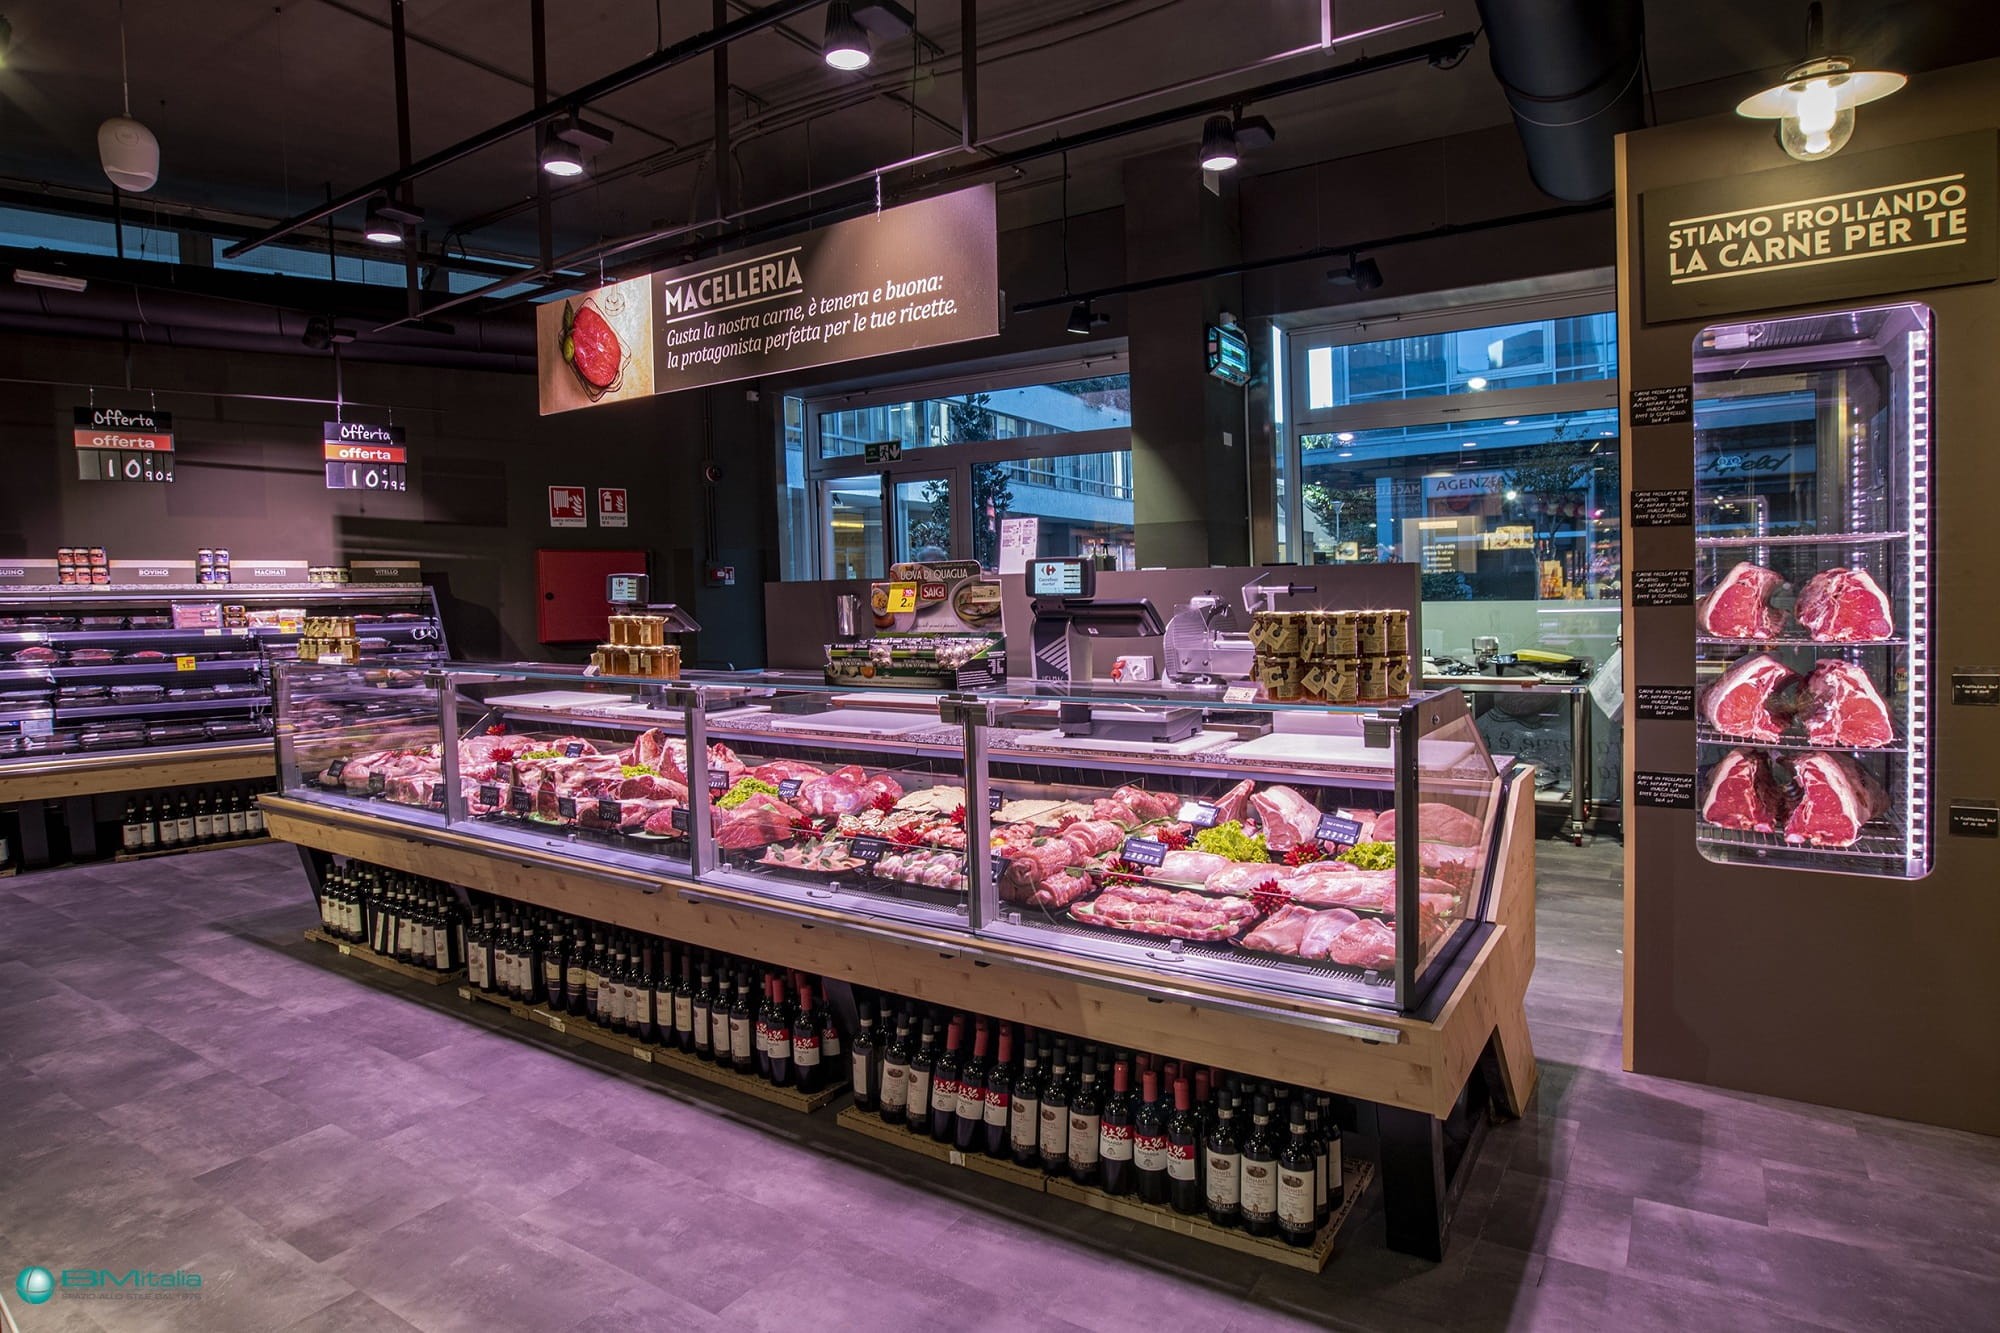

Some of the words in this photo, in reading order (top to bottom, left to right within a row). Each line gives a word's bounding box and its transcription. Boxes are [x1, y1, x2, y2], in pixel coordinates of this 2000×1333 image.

[1669, 215, 1772, 250] STIAMO
[1783, 185, 1967, 233] FROLLANDO
[1670, 249, 1708, 277] LA
[1718, 229, 1831, 268] CARNE
[1845, 218, 1912, 251] PER
[1924, 208, 1968, 238] TE
[665, 256, 803, 316] MACELLERIA
[667, 327, 700, 347] Gusta
[703, 321, 715, 340] la
[718, 314, 760, 336] nostra
[763, 305, 805, 326] carne,
[808, 297, 817, 317] è
[820, 290, 869, 315] tenera
[872, 287, 882, 304] e
[885, 275, 944, 302] buona:
[667, 351, 679, 369] la
[681, 337, 762, 371] protagonista
[764, 324, 821, 355] perfetta
[823, 318, 851, 343] per
[853, 312, 867, 333] le
[870, 306, 897, 330] tue
[899, 298, 958, 324] ricette.
[94, 409, 155, 427] Offerta
[341, 424, 391, 441] Offerta
[92, 434, 156, 449] offerta
[339, 447, 391, 461] offerta
[900, 569, 923, 581] UOVA
[924, 569, 932, 579] DI
[934, 567, 968, 579] QUAGLIA
